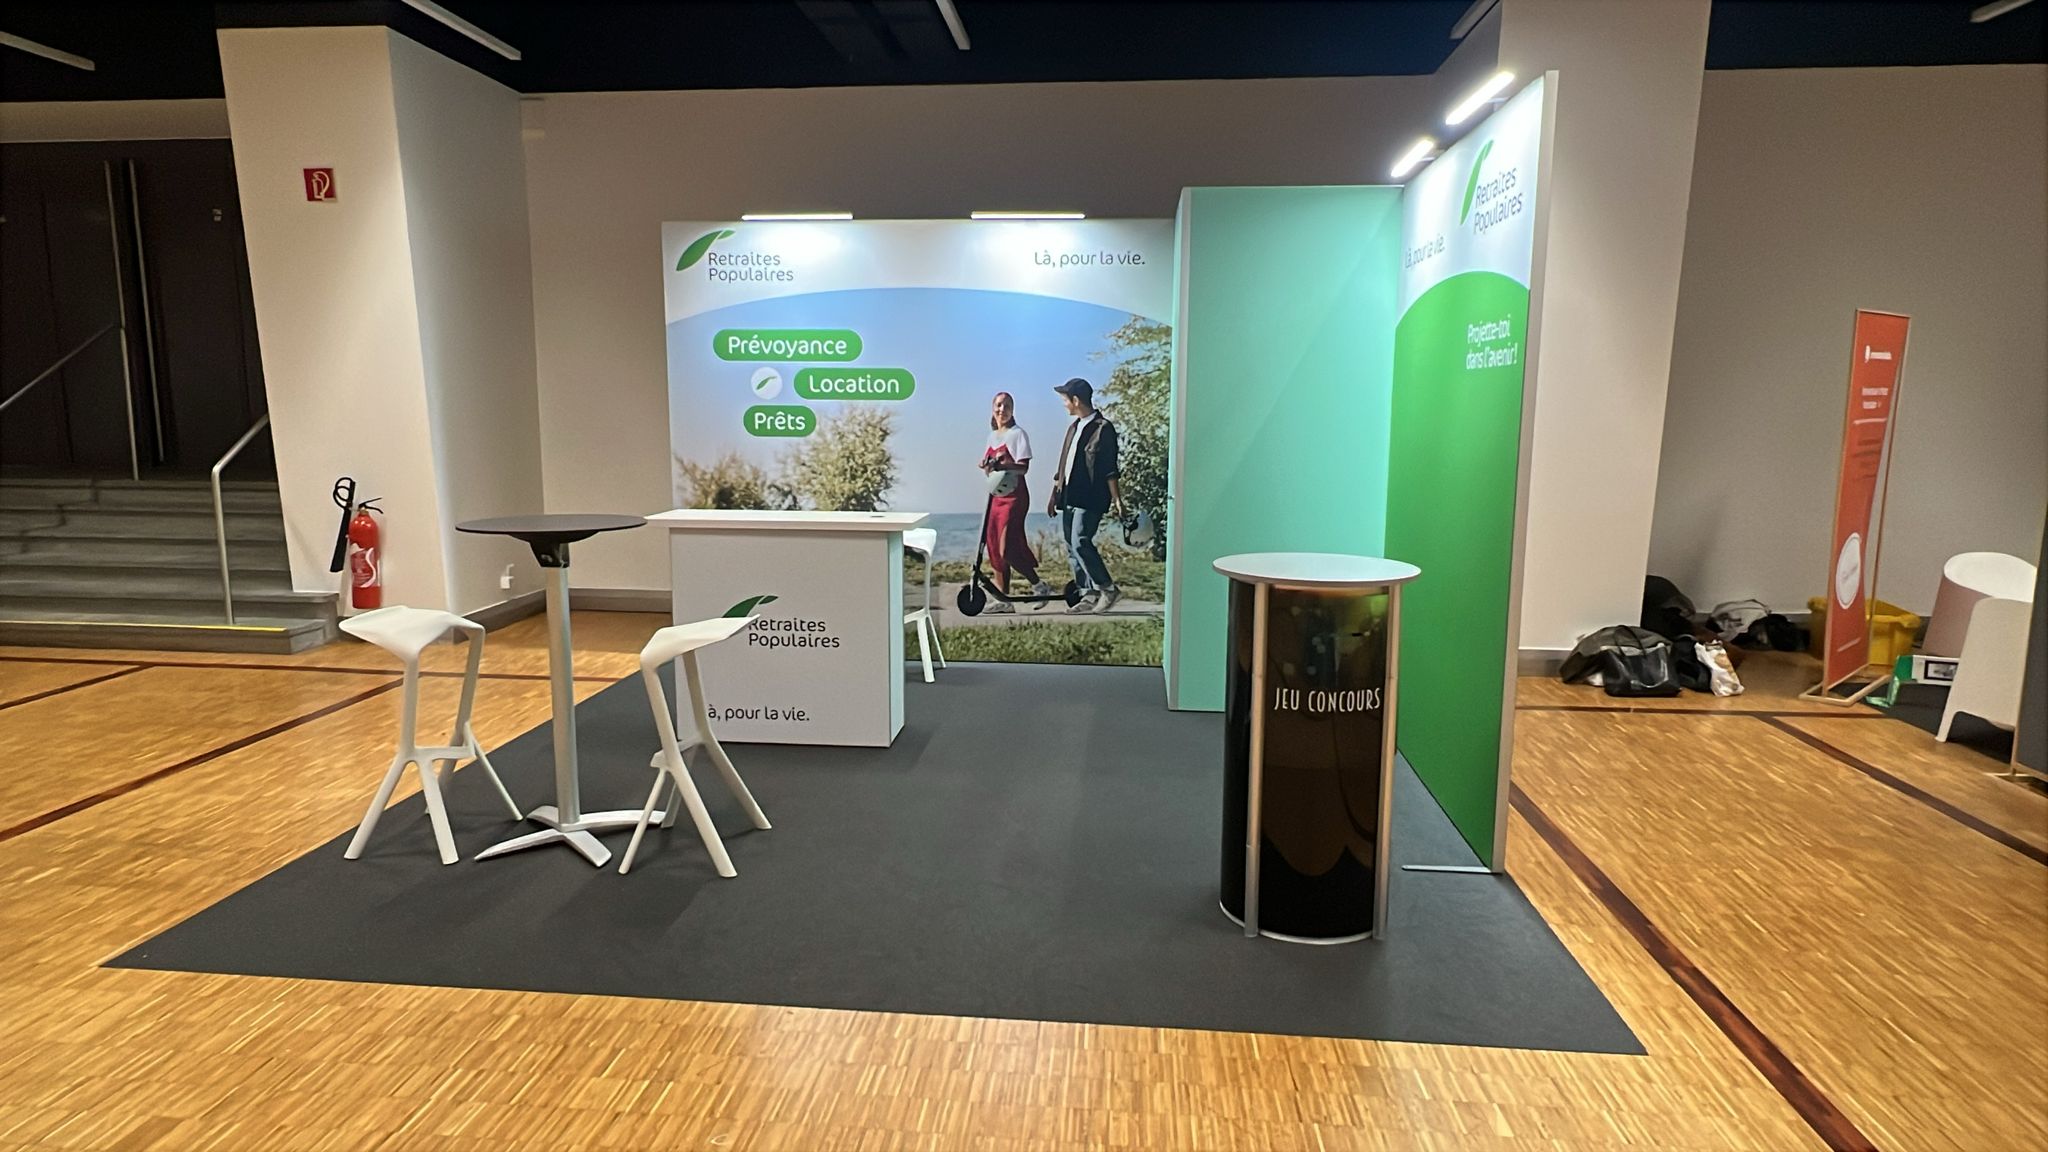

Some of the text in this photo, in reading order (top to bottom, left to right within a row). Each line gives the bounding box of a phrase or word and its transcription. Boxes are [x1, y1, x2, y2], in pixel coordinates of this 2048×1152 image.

[1475, 167, 1516, 208] Retraites
[1473, 192, 1523, 235] Populaires
[708, 251, 781, 266] Retraites
[1034, 249, 1146, 268] Là, pour la vie.
[708, 266, 795, 284] Populaires
[1467, 312, 1511, 348] Projette-toi
[727, 334, 848, 359] Prévoyance
[1466, 348, 1484, 370] dans
[808, 373, 901, 394] Location
[753, 410, 806, 431] Prêts
[748, 632, 840, 650] Populaires
[1273, 687, 1381, 713] JEU CONCOURS
[707, 703, 810, 722] à, pour la vie.
